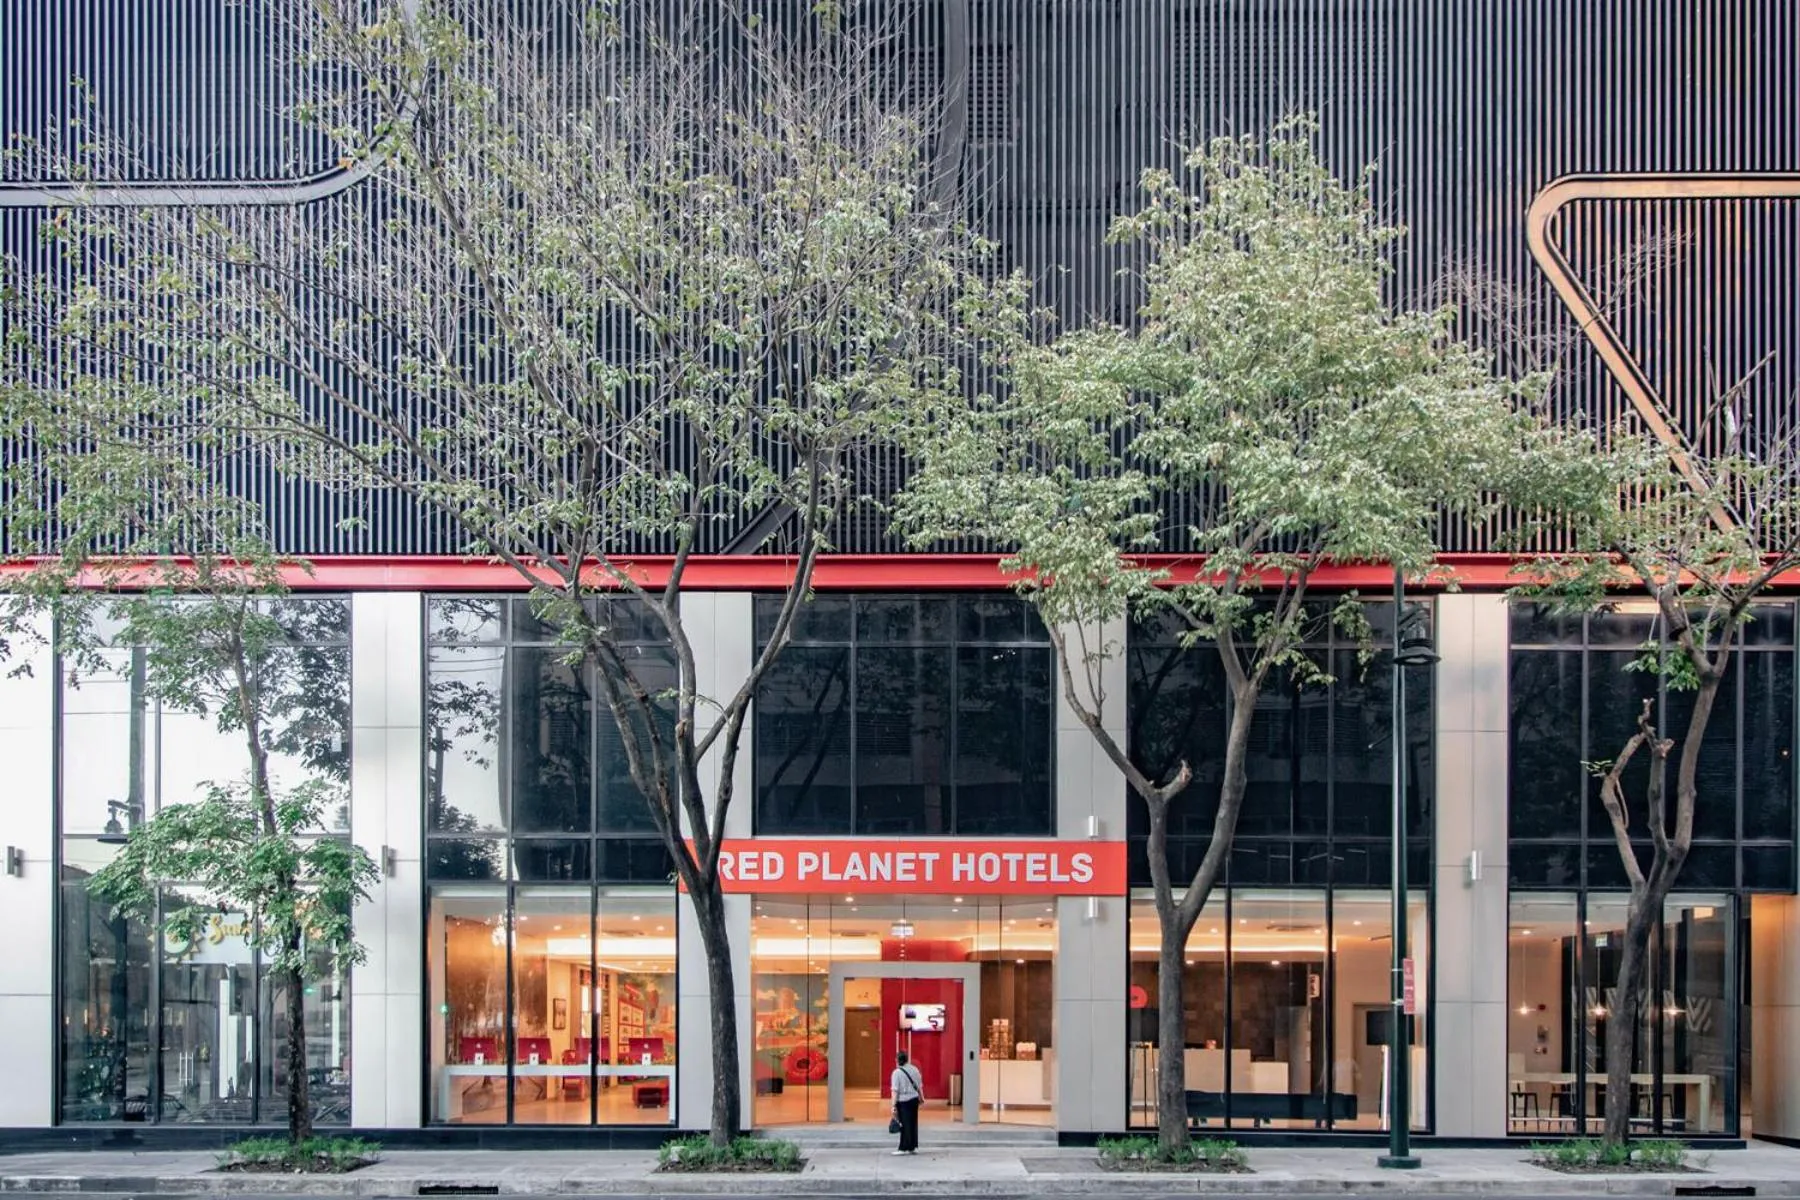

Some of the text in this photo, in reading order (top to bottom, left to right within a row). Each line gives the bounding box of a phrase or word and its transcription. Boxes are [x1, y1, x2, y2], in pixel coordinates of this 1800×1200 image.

[718, 851, 1094, 883] RED PLANET HOTELS
